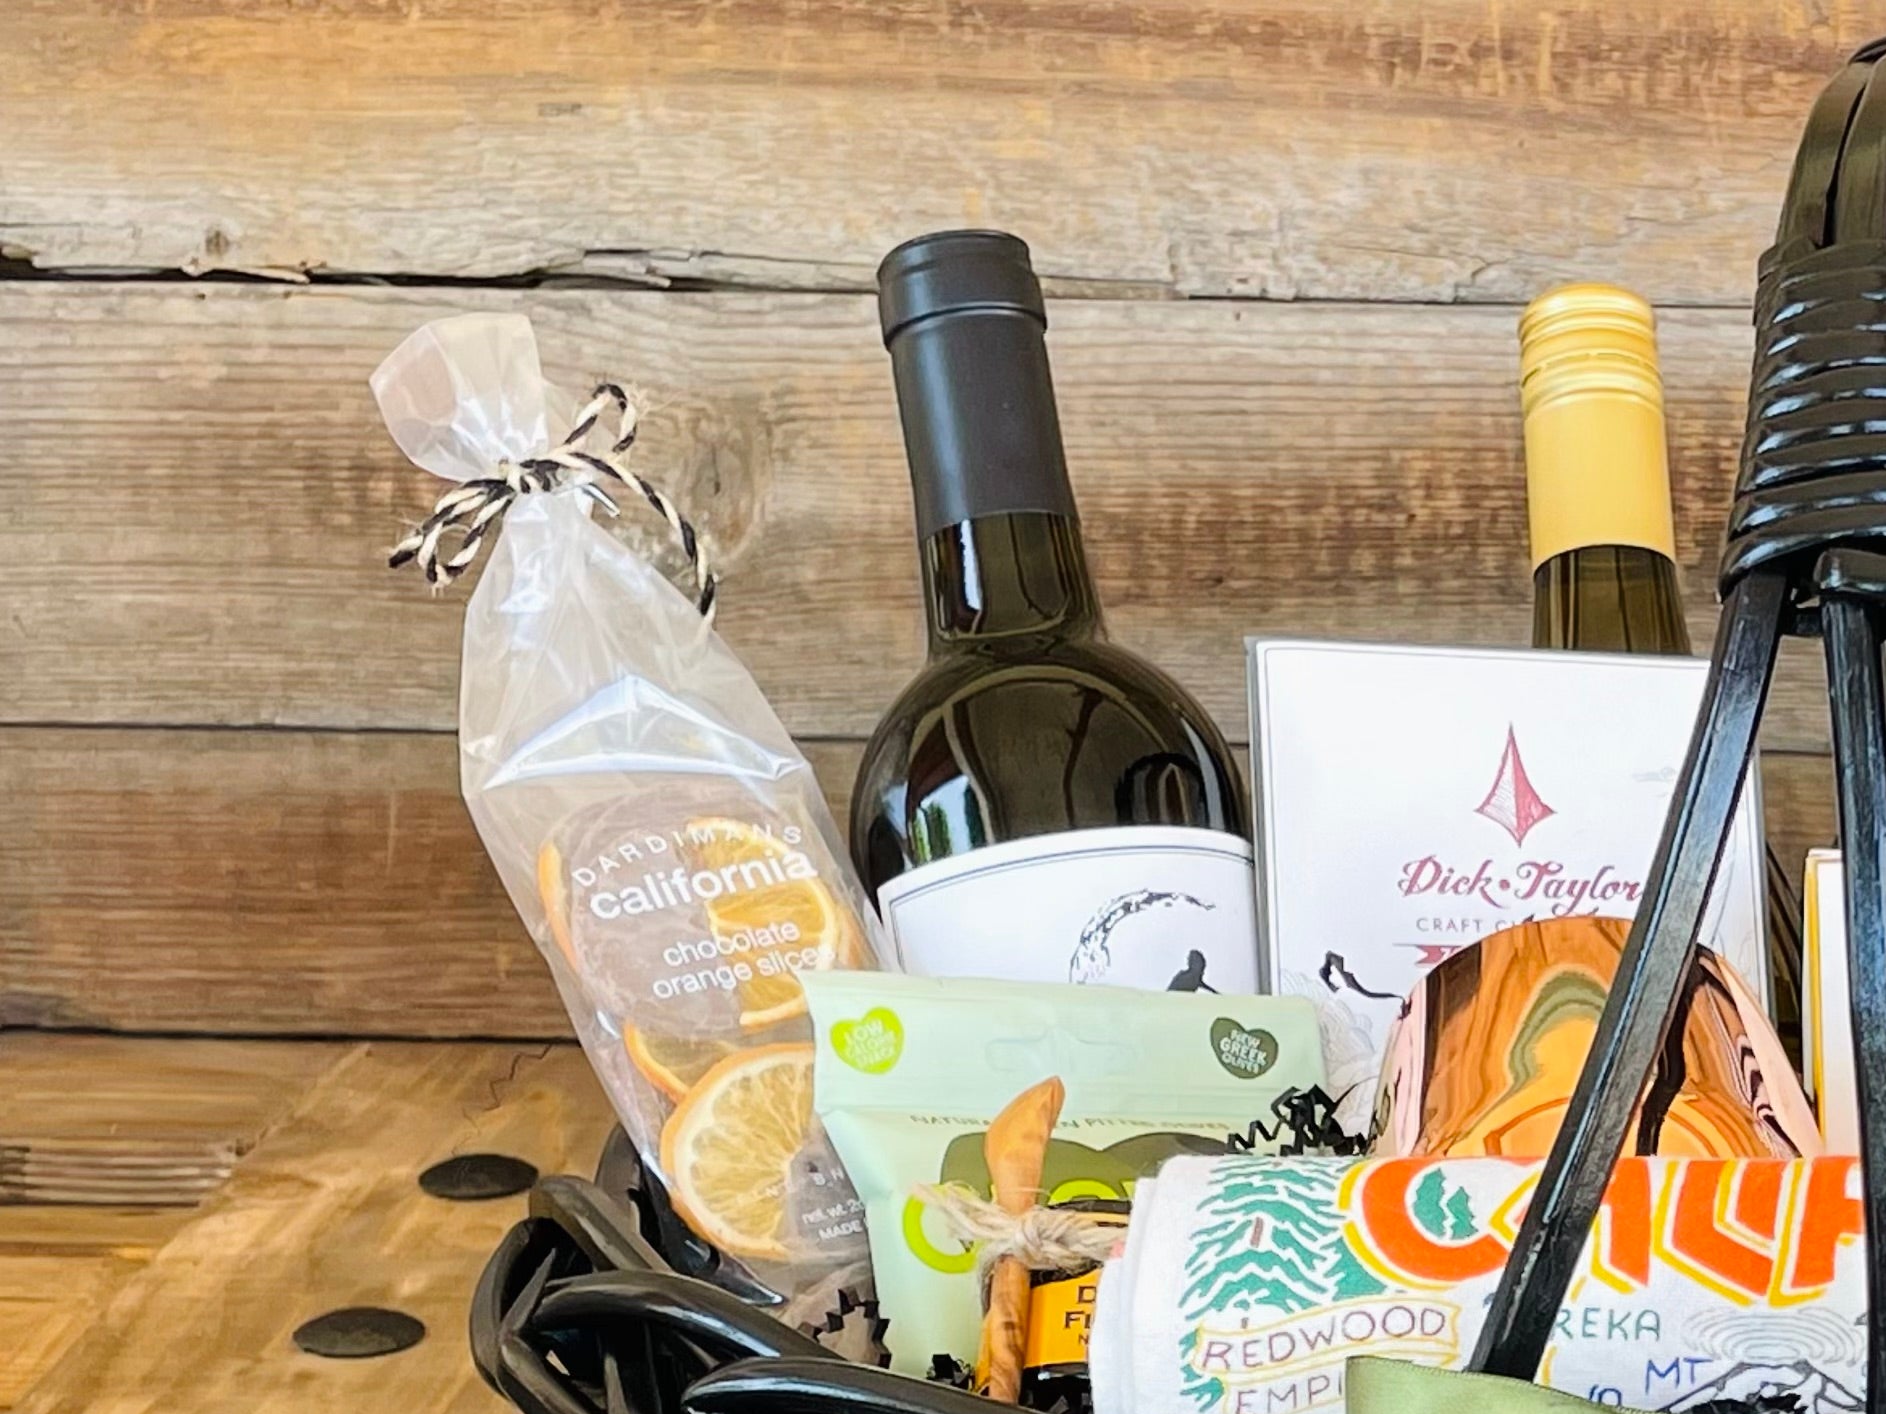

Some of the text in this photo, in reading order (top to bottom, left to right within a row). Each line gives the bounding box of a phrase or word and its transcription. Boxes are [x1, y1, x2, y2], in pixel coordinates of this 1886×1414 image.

[572, 823, 802, 888] DARDIMANS
[589, 850, 819, 920] california
[1397, 854, 1643, 917] Dick Taylor
[662, 920, 801, 968] chocolate
[1415, 916, 1484, 933] CRAFT
[652, 961, 754, 999] orange
[1219, 1036, 1267, 1067] GREEK
[818, 1219, 863, 1240] MADE
[1202, 1305, 1446, 1371] REDWOOD
[1646, 1358, 1713, 1395] MT
